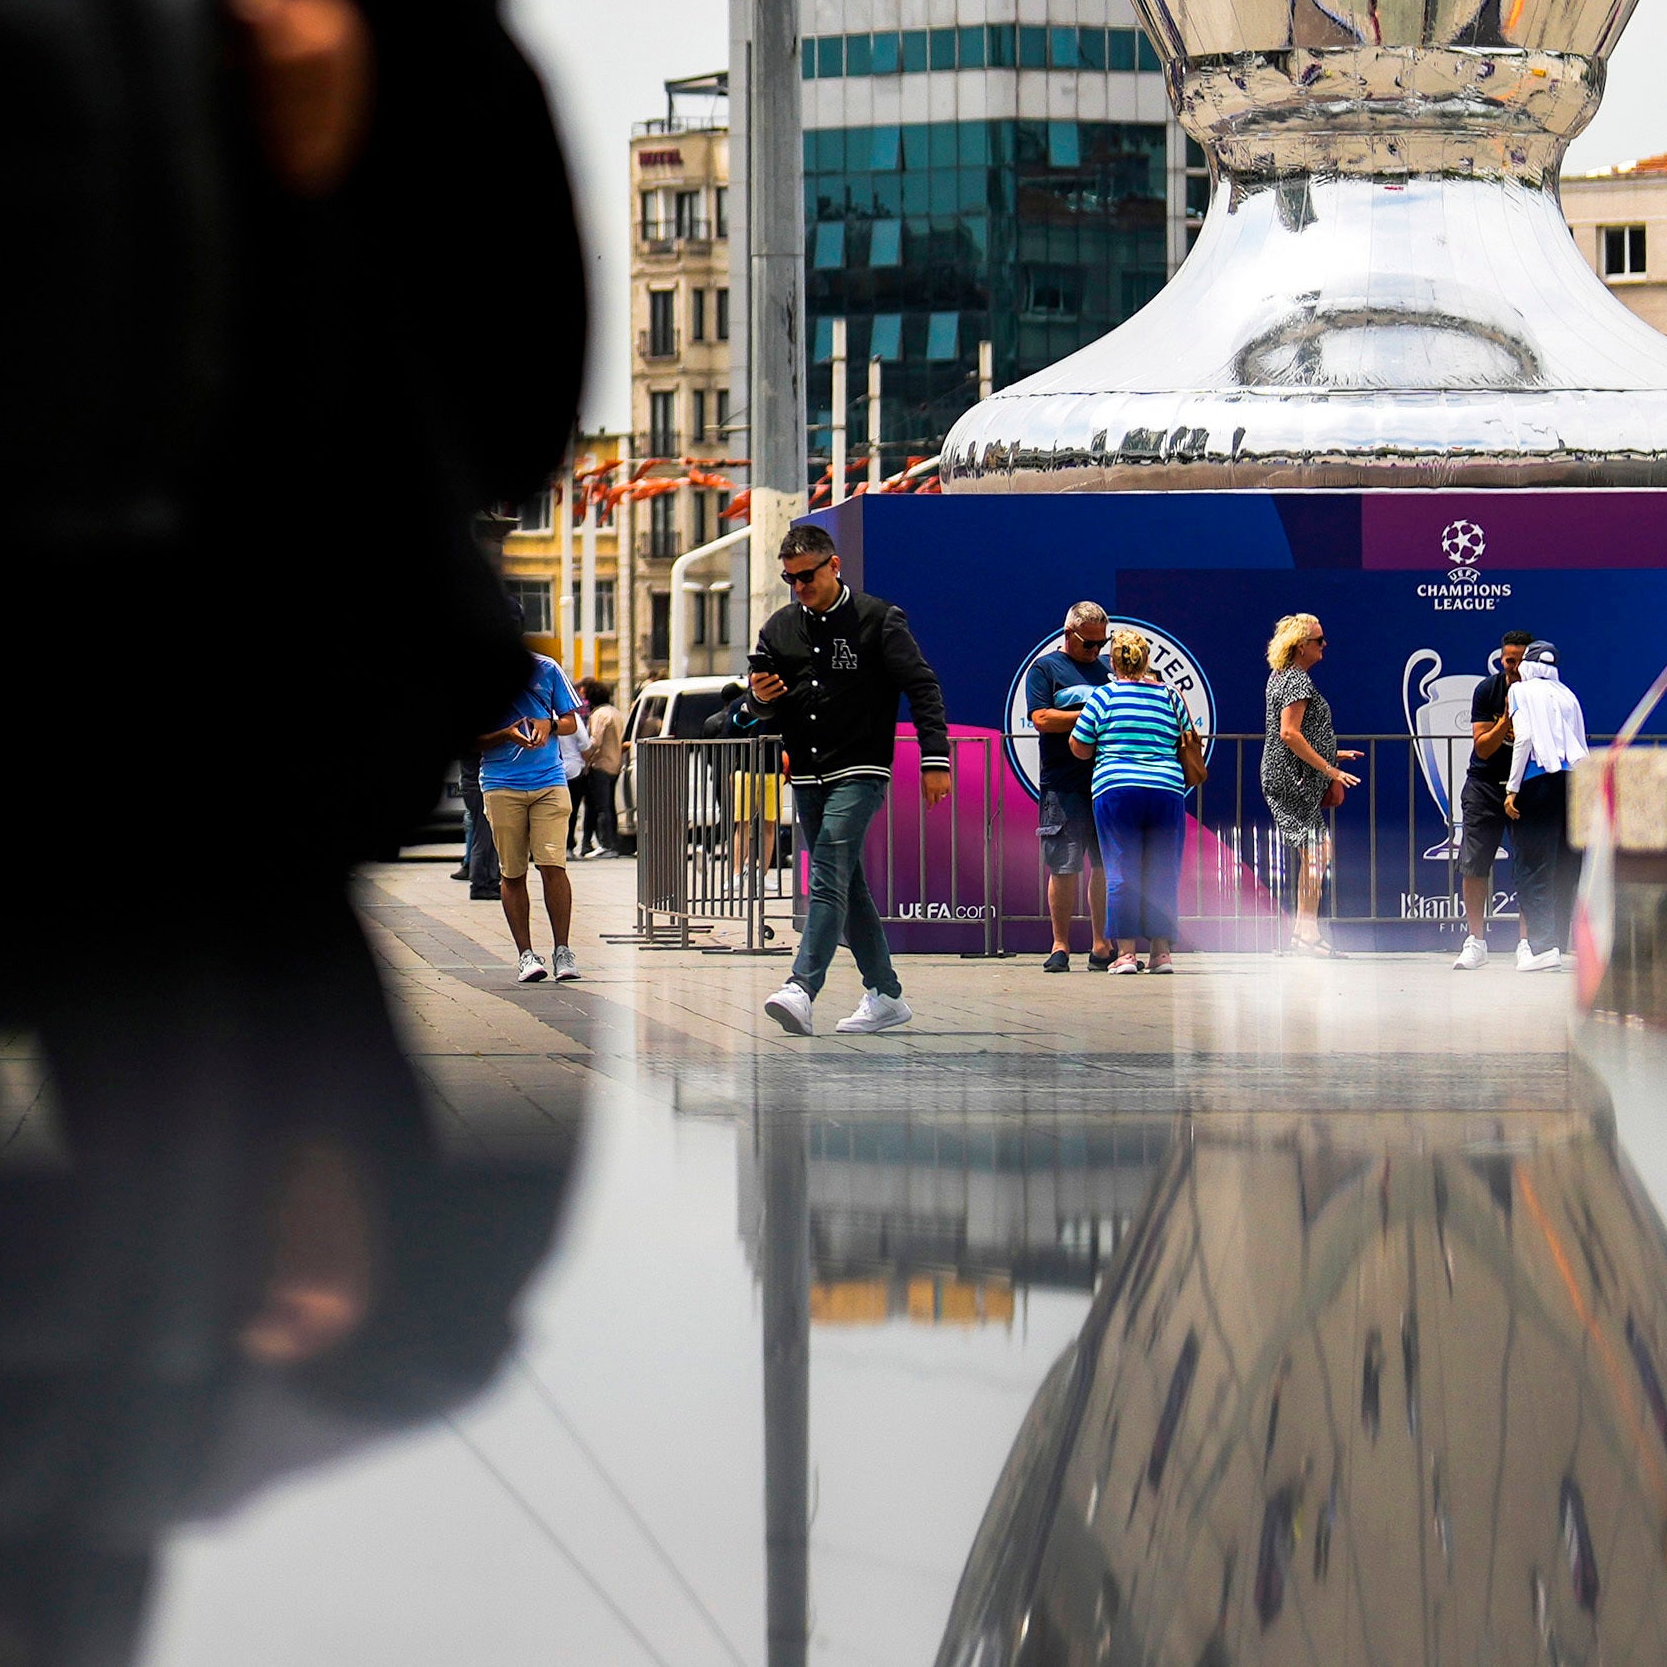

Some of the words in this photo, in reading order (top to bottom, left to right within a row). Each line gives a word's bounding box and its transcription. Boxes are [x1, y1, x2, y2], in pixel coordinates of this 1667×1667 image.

[1449, 569, 1478, 582] UEFA
[1416, 583, 1512, 597] CHAMPIONS
[1433, 597, 1496, 611] LEAGUE
[898, 902, 996, 919] UEFAcom
[1439, 923, 1492, 932] FINL
